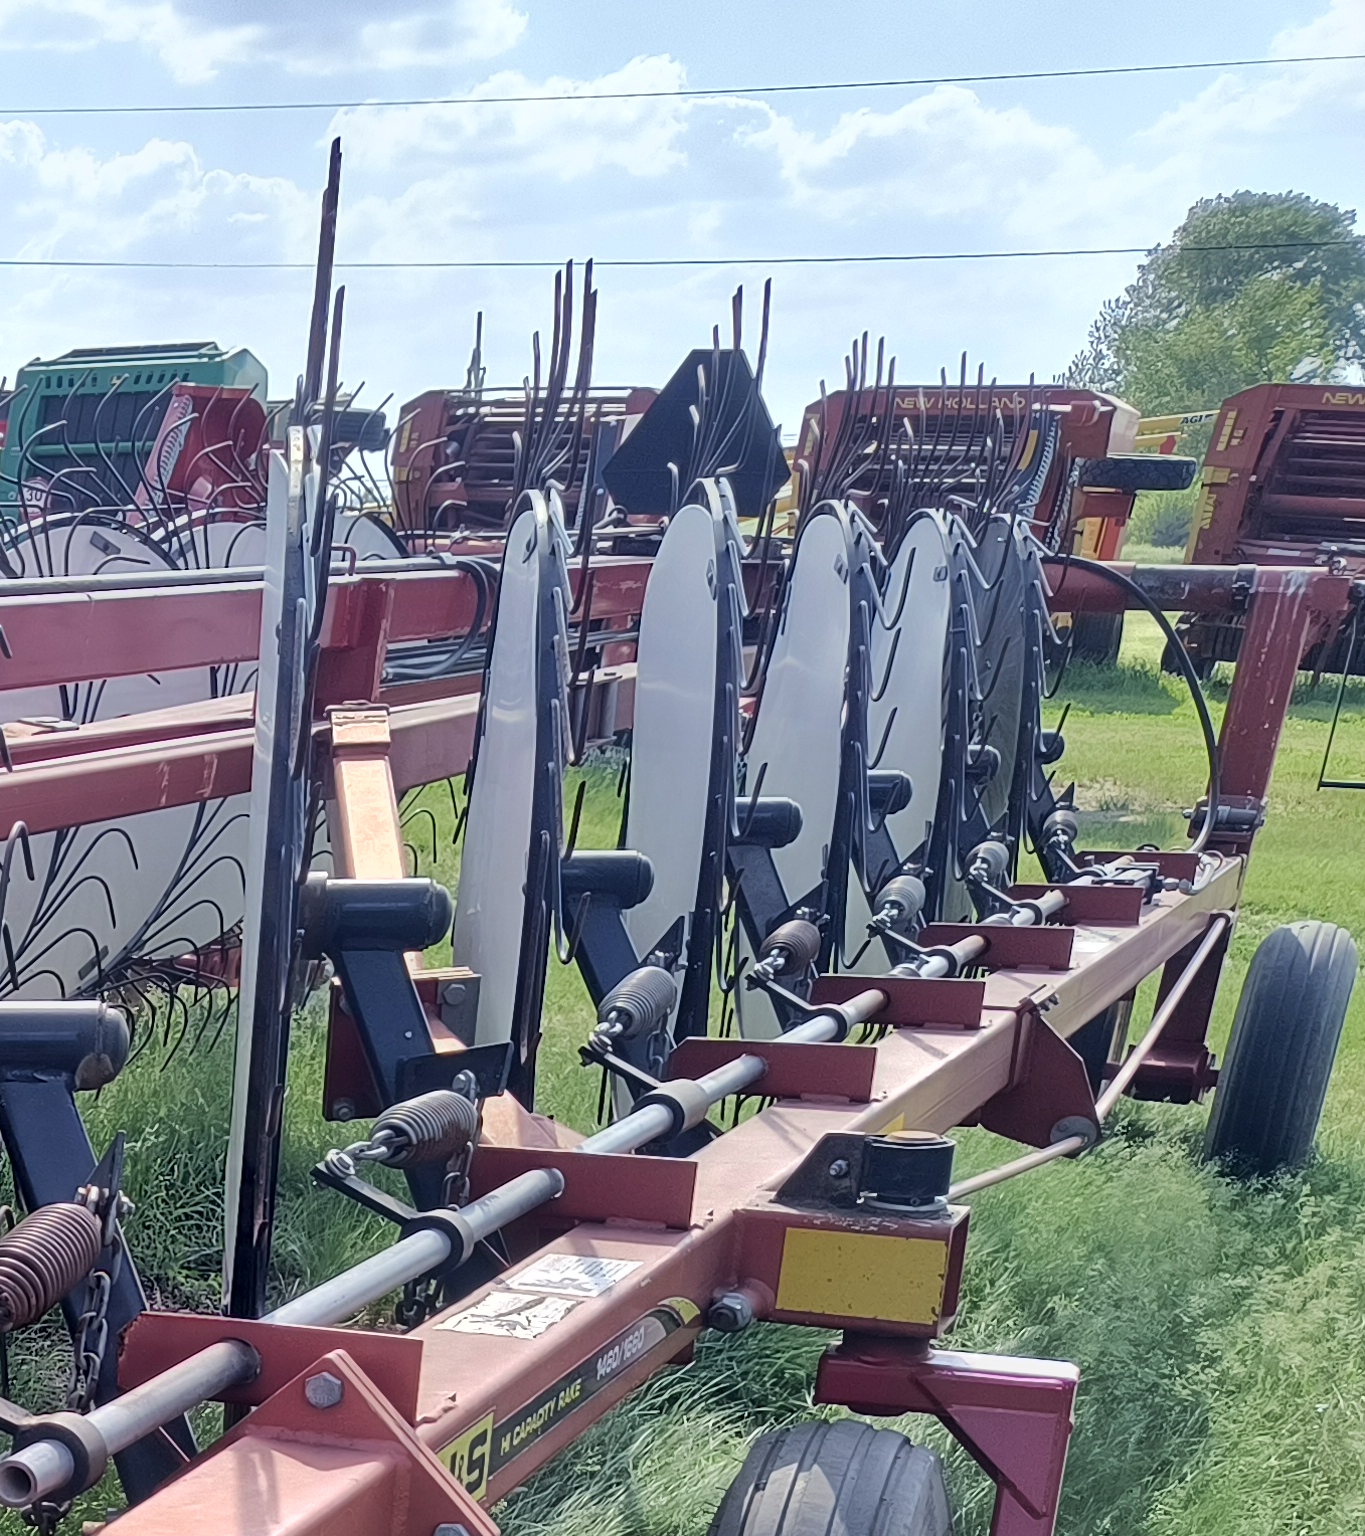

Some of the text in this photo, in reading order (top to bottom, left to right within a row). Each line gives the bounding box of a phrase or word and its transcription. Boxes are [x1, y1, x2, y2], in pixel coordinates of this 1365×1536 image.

[895, 397, 1026, 409] NEW HOLLAND
[1180, 414, 1203, 425] AGI
[25, 488, 43, 502] 30
[500, 1436, 511, 1456] HI
[512, 1398, 556, 1446] CAPACITY
[557, 1378, 582, 1411] RAKE
